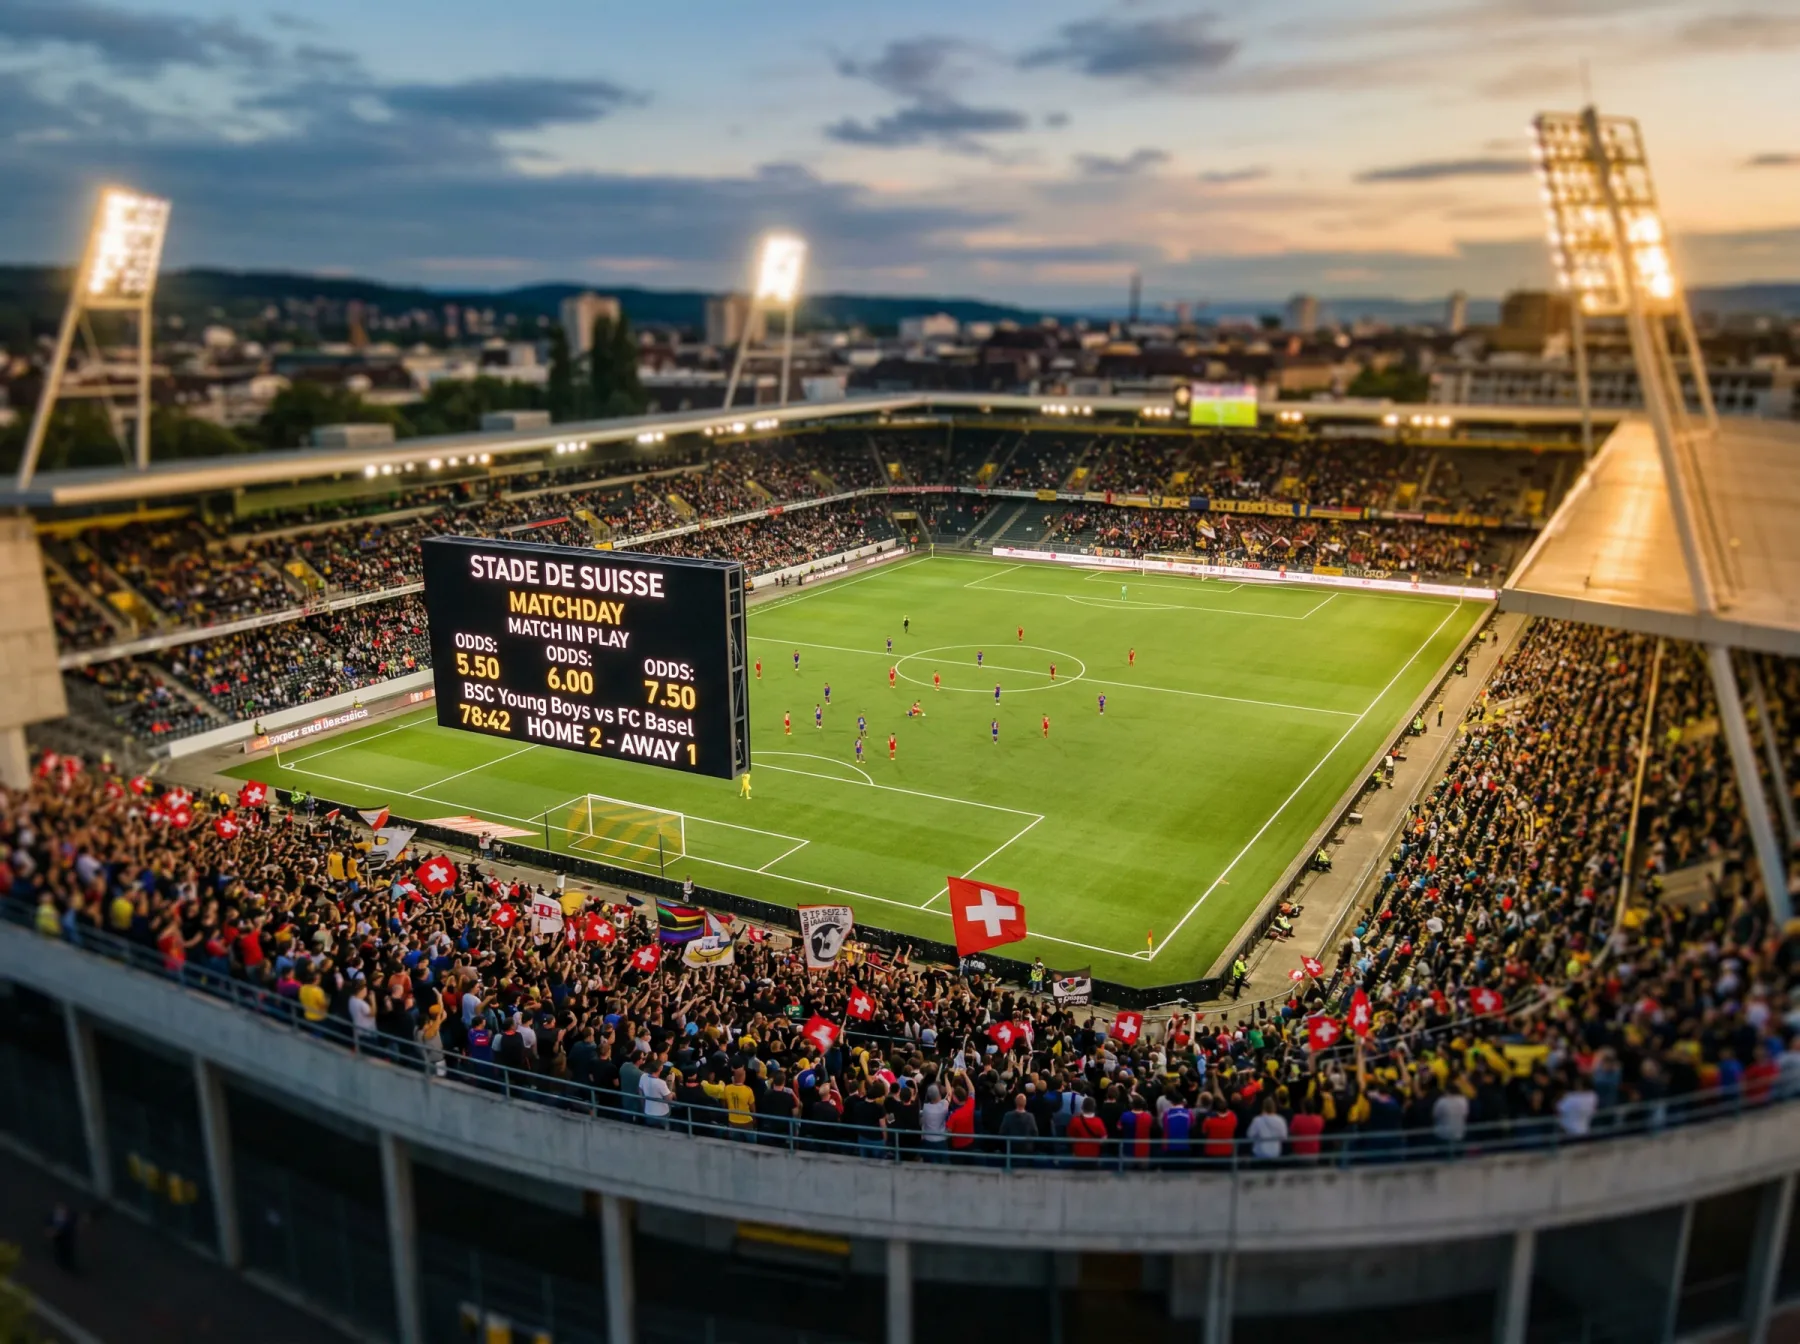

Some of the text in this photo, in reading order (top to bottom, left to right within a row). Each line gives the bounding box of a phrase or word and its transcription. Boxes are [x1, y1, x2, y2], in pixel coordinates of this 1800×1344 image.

[470, 554, 665, 598] STADE DE SUISSE
[509, 590, 625, 626] MATCHDAY
[455, 632, 498, 654] ODDS:
[507, 616, 630, 649] MATCH IN PLAY
[456, 652, 500, 681] 5.50
[545, 644, 593, 668] ODDS:
[644, 658, 695, 682] ODDS:
[547, 666, 594, 695] 6.00
[644, 679, 696, 711] 7.50
[463, 681, 495, 704] BSC
[497, 686, 548, 719] Young
[550, 695, 592, 723] Boys
[595, 707, 614, 725] vs
[617, 707, 641, 728] FC
[644, 711, 695, 738] Basel
[459, 703, 511, 733] 78:42
[526, 715, 585, 747] HOME
[588, 726, 603, 749] 2
[620, 733, 680, 762] AWAY
[686, 743, 697, 767] 1
